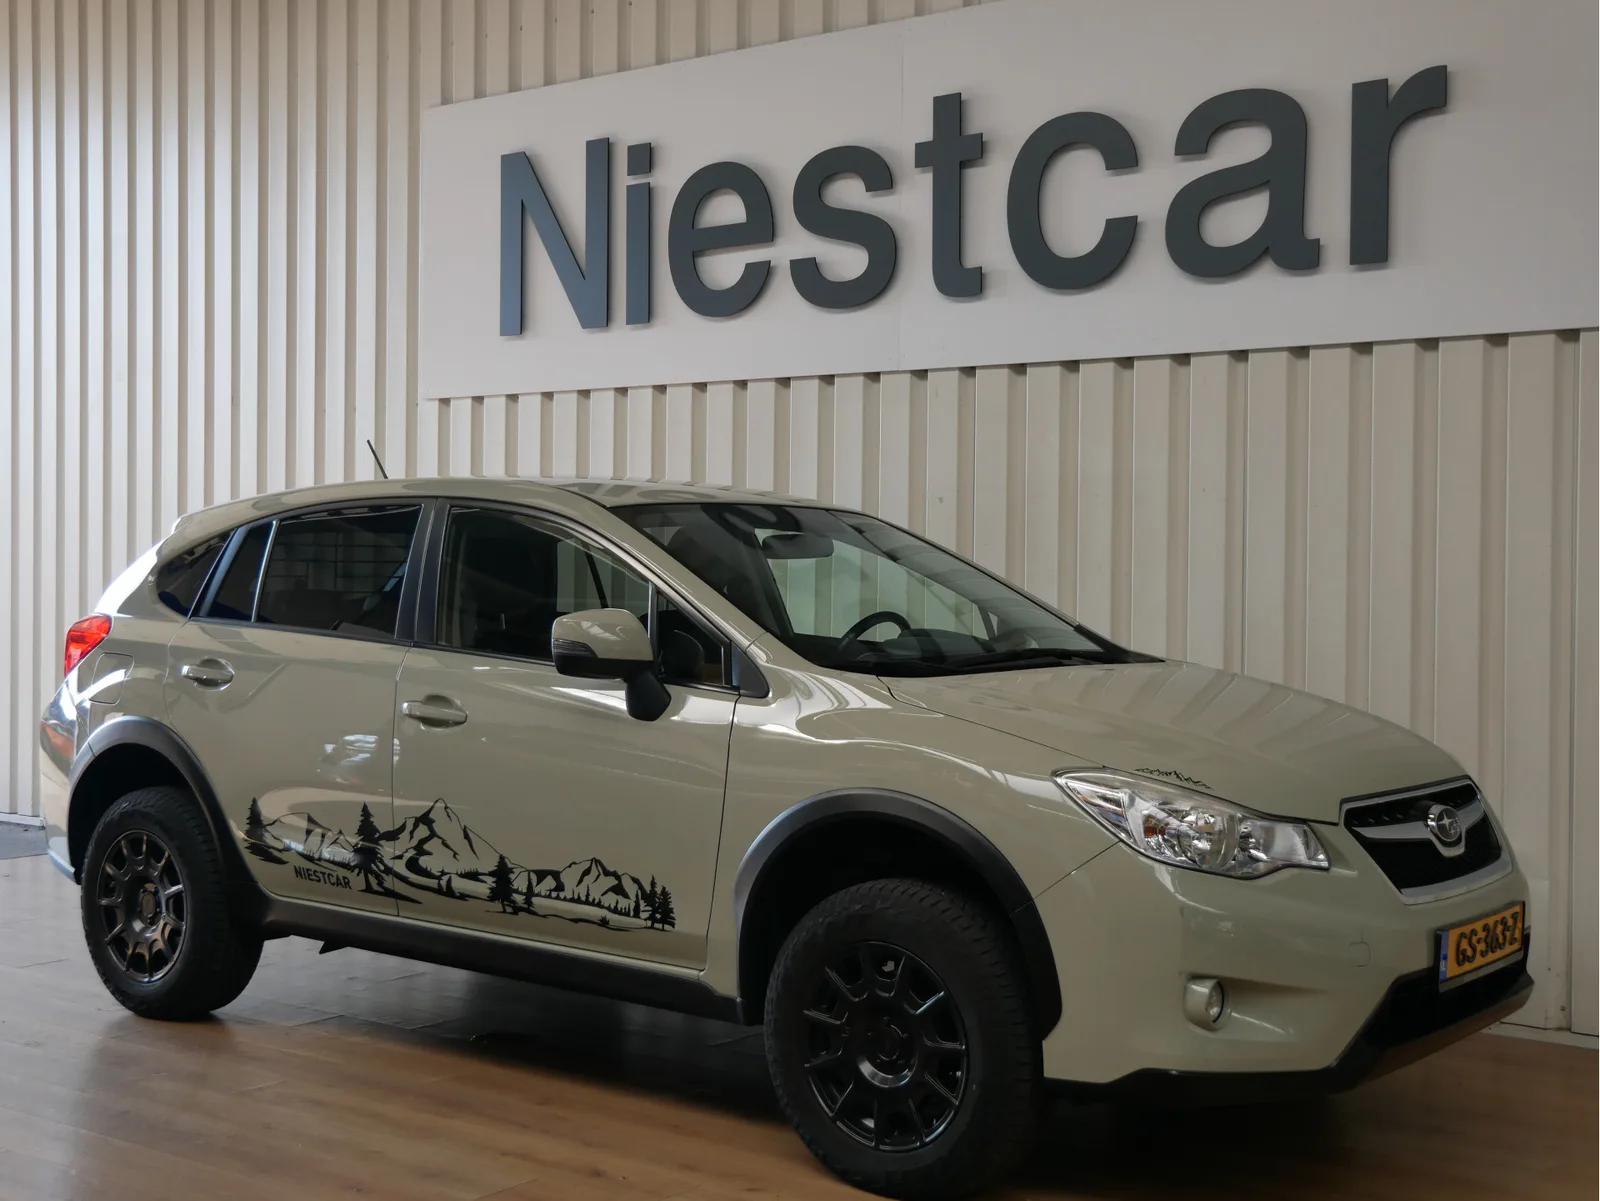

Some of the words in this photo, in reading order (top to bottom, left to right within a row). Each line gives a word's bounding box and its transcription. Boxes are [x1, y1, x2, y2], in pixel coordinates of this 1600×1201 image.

[500, 65, 1448, 336] Niestcar
[294, 866, 352, 889] NIESTCAR
[1457, 912, 1519, 966] GS-363-Z
